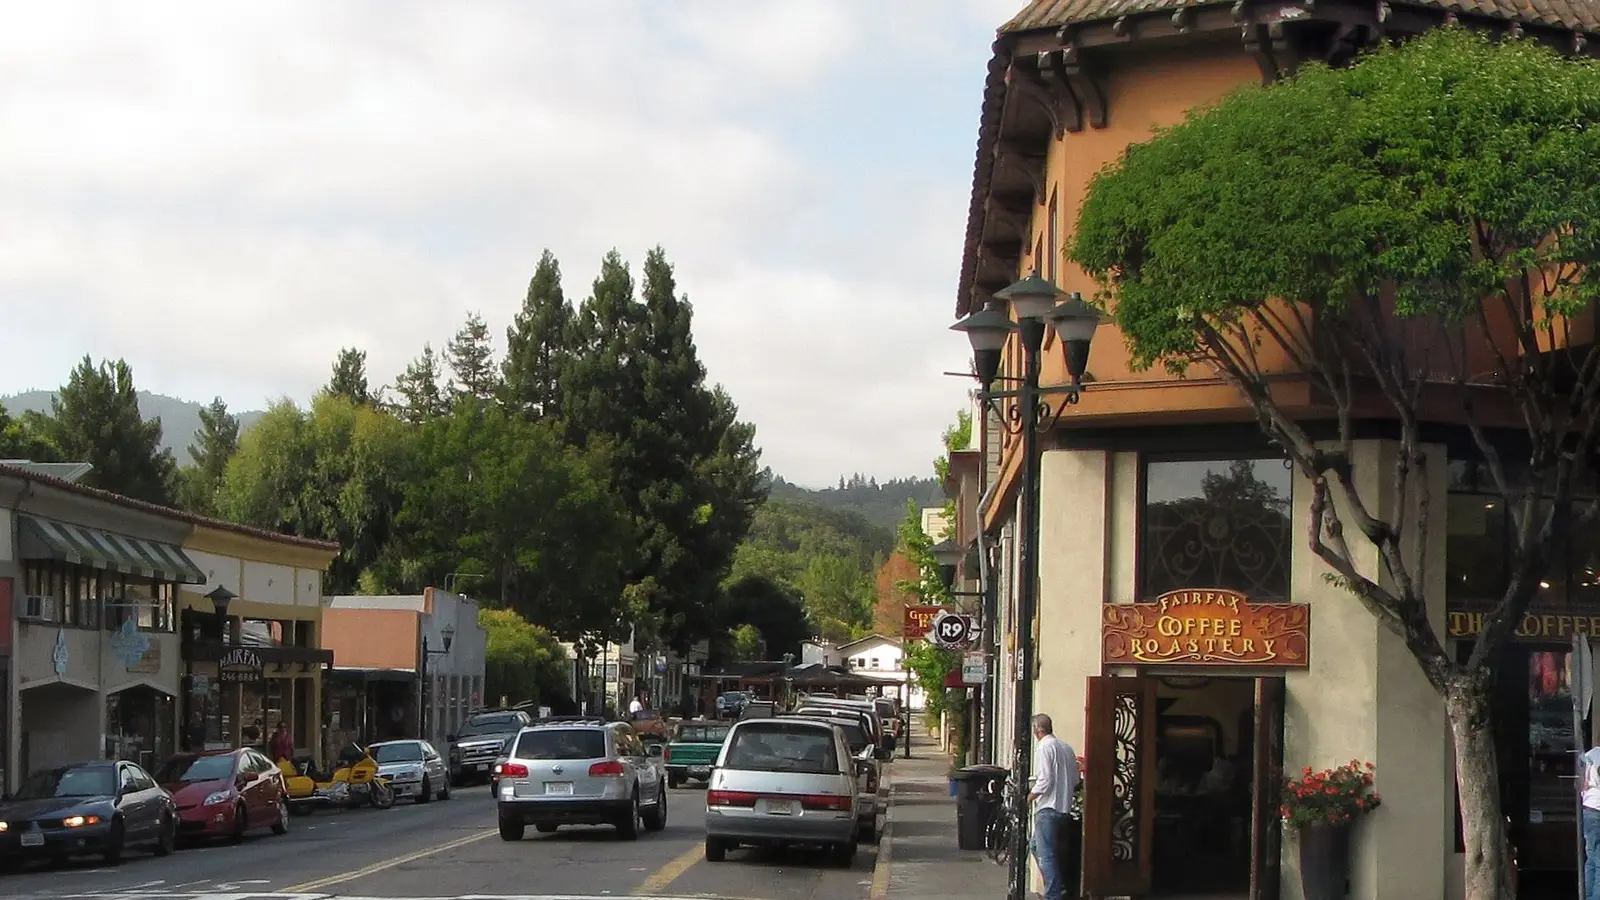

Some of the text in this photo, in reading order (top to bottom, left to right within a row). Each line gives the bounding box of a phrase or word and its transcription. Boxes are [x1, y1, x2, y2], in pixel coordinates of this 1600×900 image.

[1159, 592, 1240, 614] FAIRFAX
[941, 622, 963, 638] R9
[1158, 615, 1242, 636] COFFEE
[1448, 611, 1487, 636] TH
[219, 648, 263, 669] HAIRFAX
[1131, 638, 1277, 660] ROASTERY
